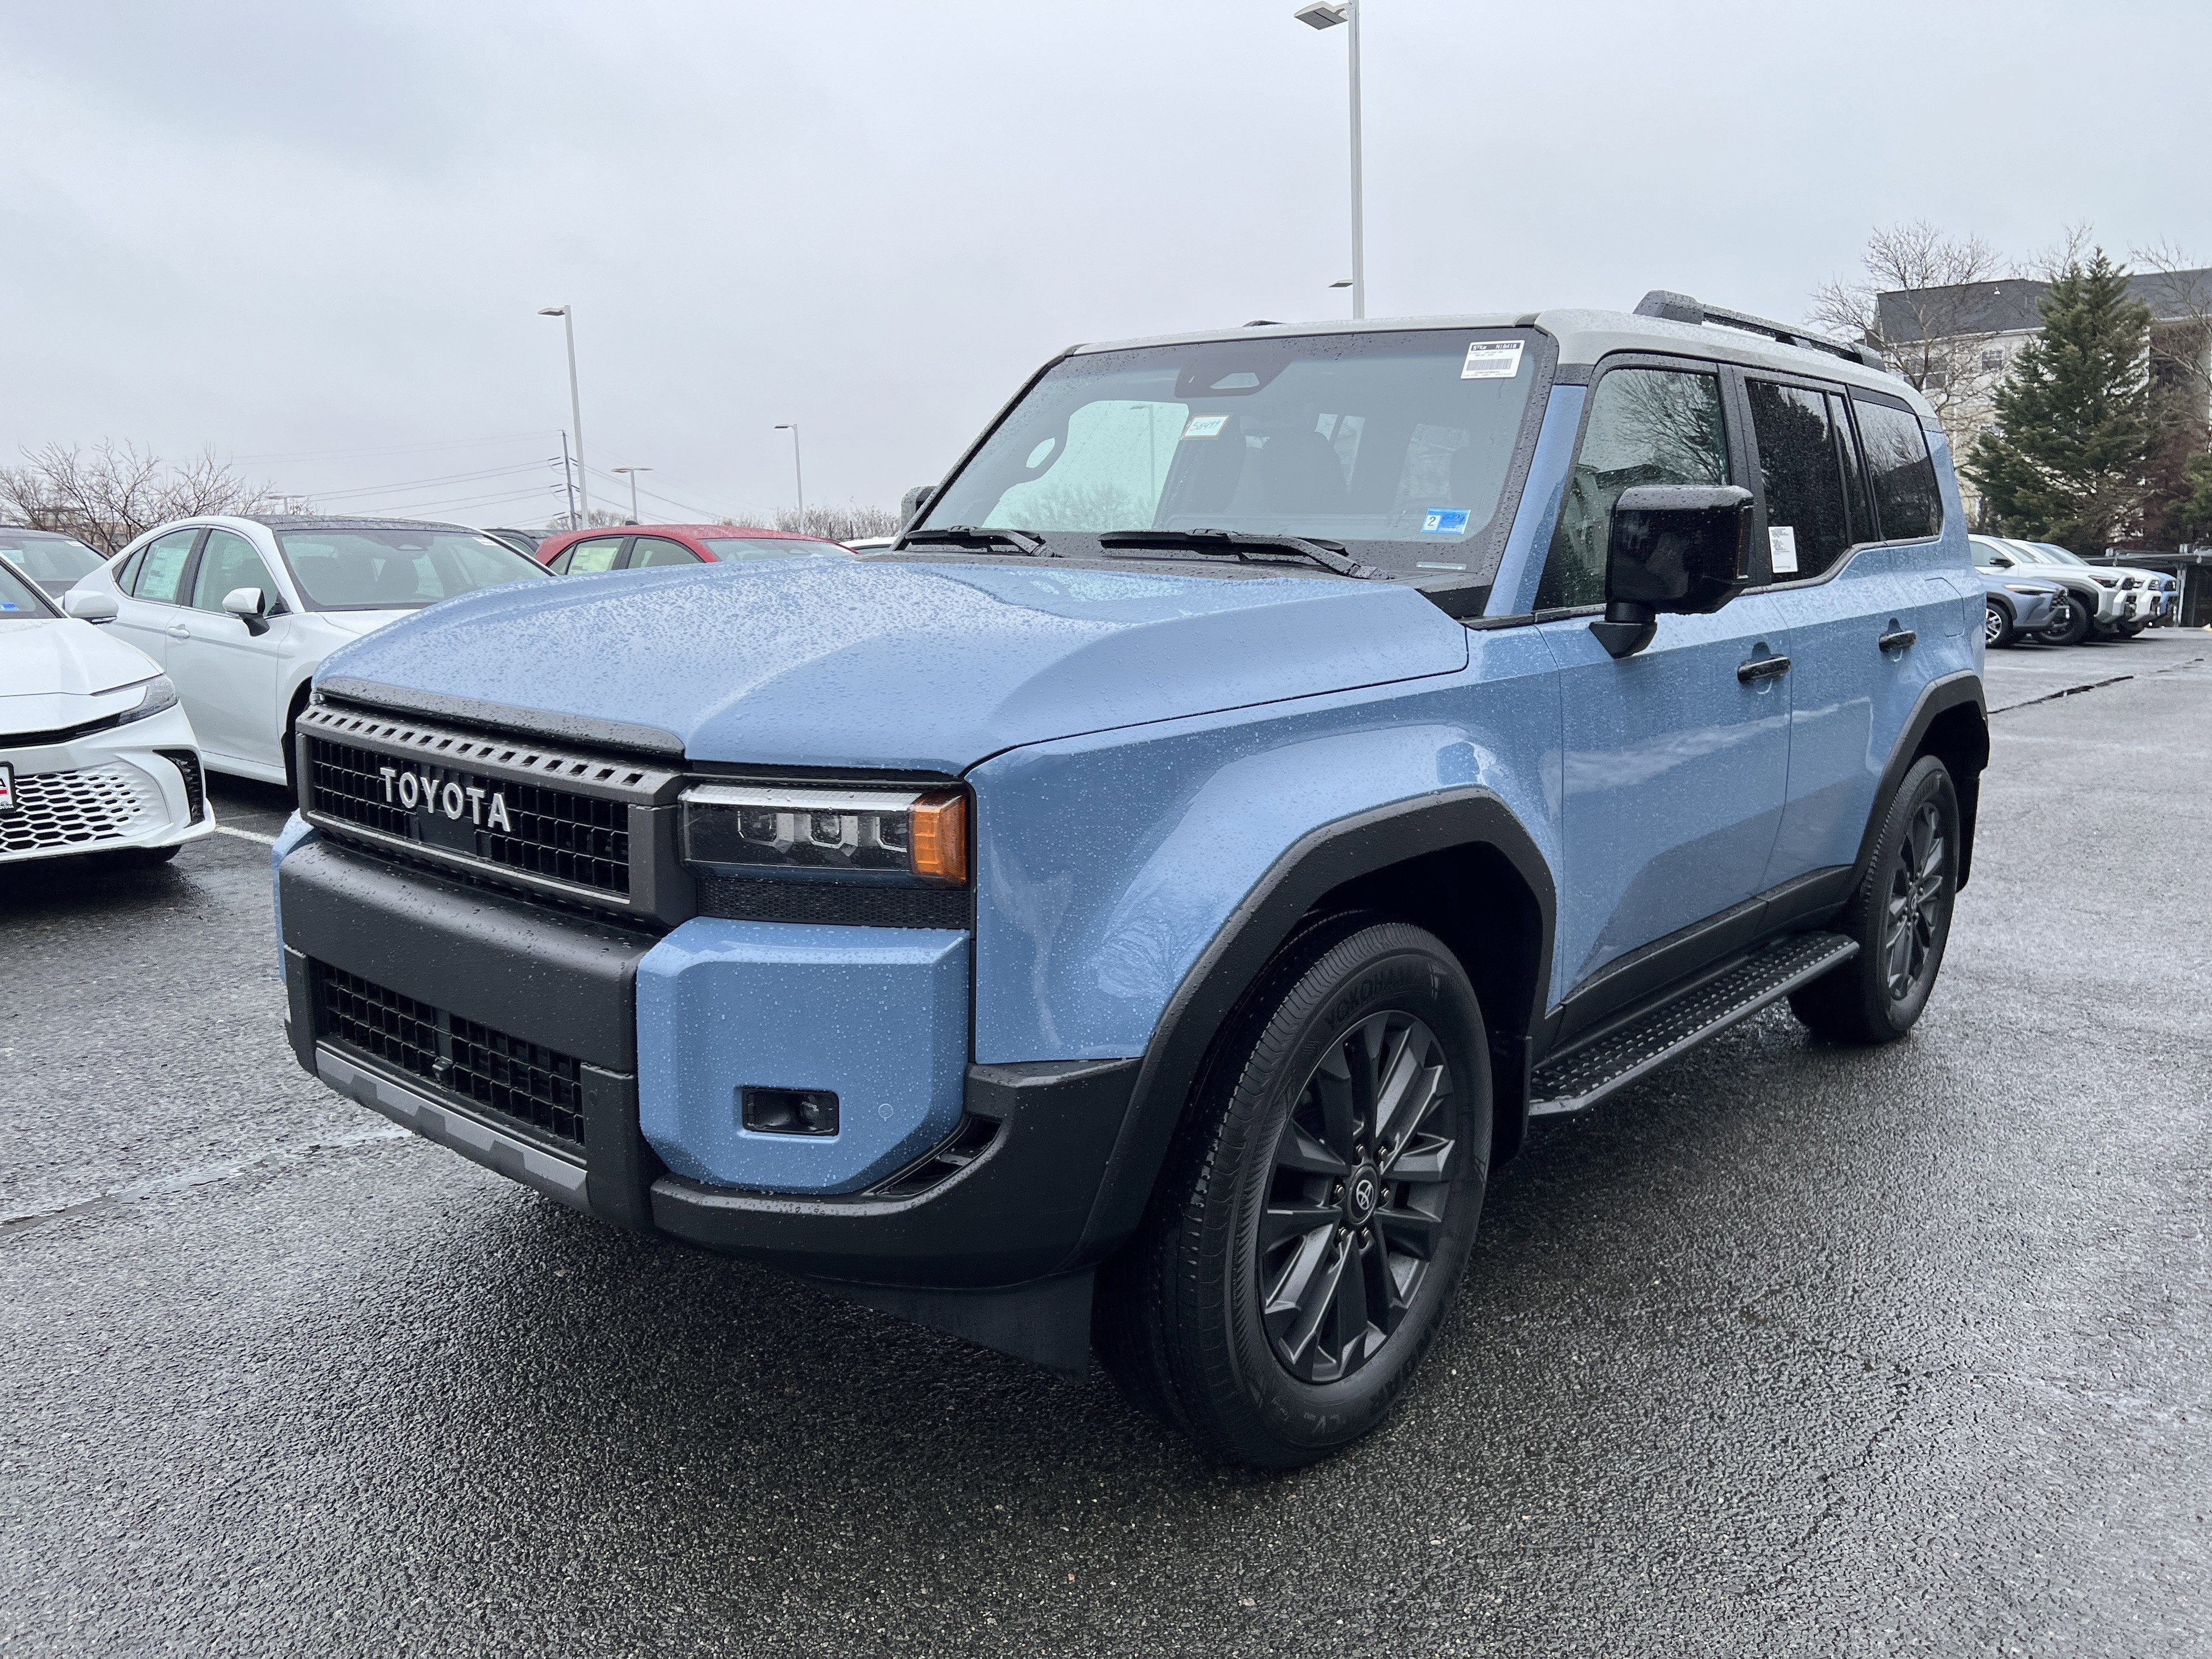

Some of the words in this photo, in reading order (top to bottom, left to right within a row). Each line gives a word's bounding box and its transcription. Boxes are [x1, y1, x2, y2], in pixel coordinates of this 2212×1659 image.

[1427, 516, 1436, 527] 2
[1454, 514, 1465, 523] 27
[380, 766, 512, 832] TOYOTA
